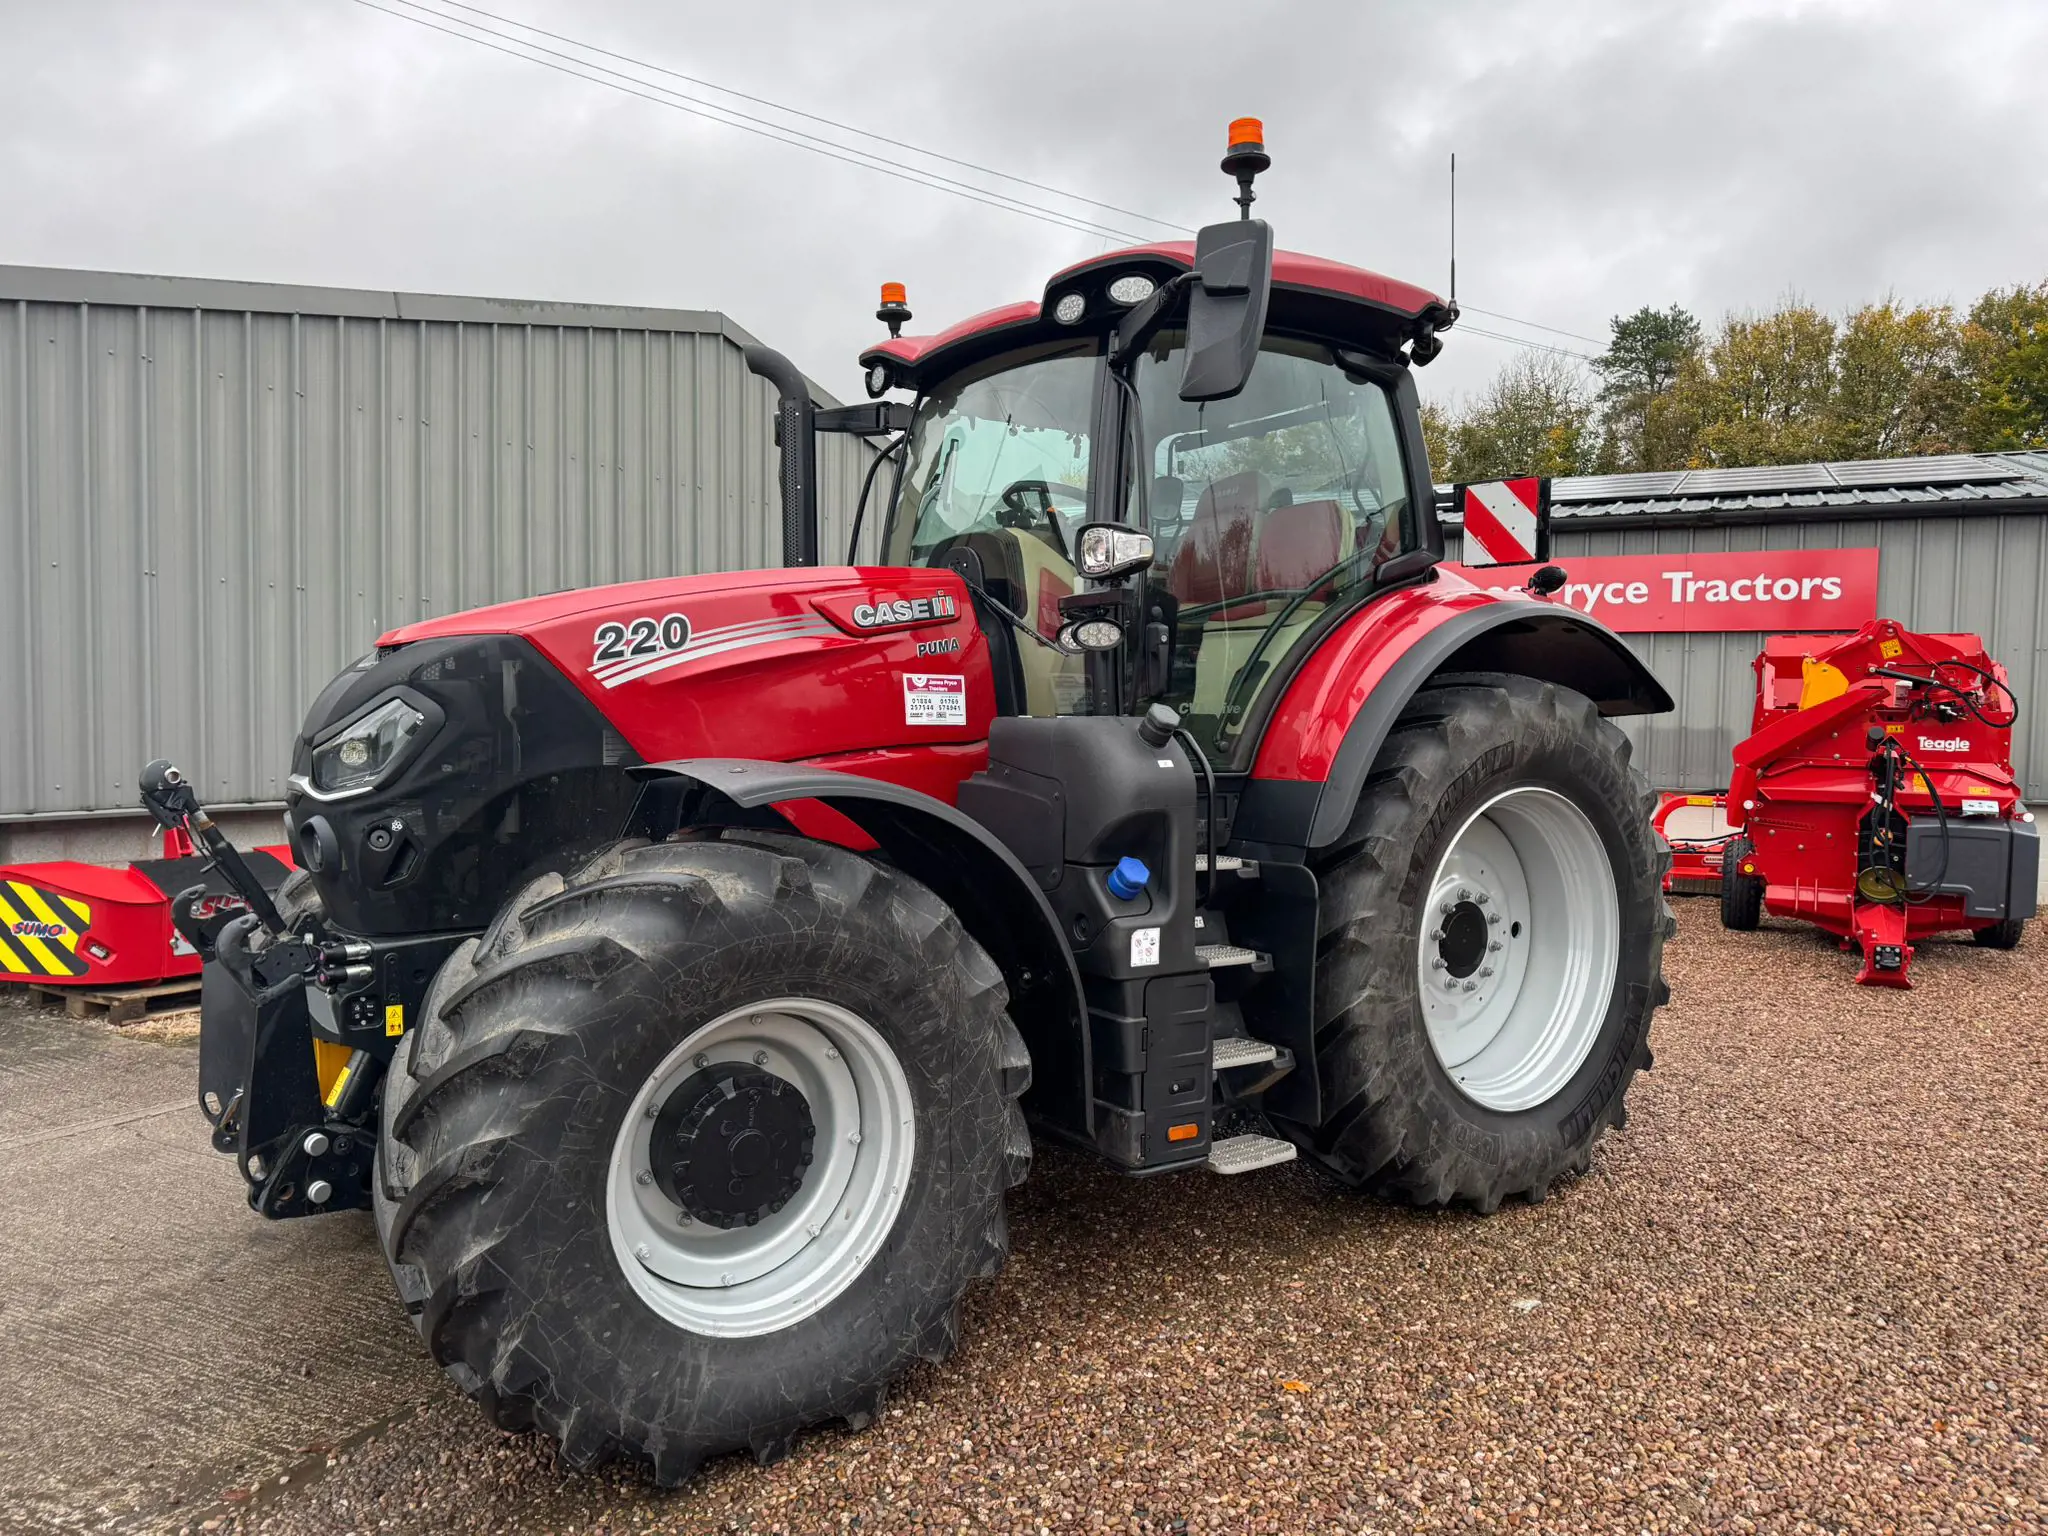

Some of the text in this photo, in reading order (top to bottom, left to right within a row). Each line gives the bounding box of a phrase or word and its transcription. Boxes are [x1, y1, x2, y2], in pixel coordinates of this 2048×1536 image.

[1562, 571, 1842, 613] ryce Tractors
[853, 598, 930, 627] CASE
[593, 612, 692, 665] 220
[916, 637, 960, 658] PUMA
[1917, 736, 1970, 752] Teagle
[12, 921, 67, 937] SUMO
